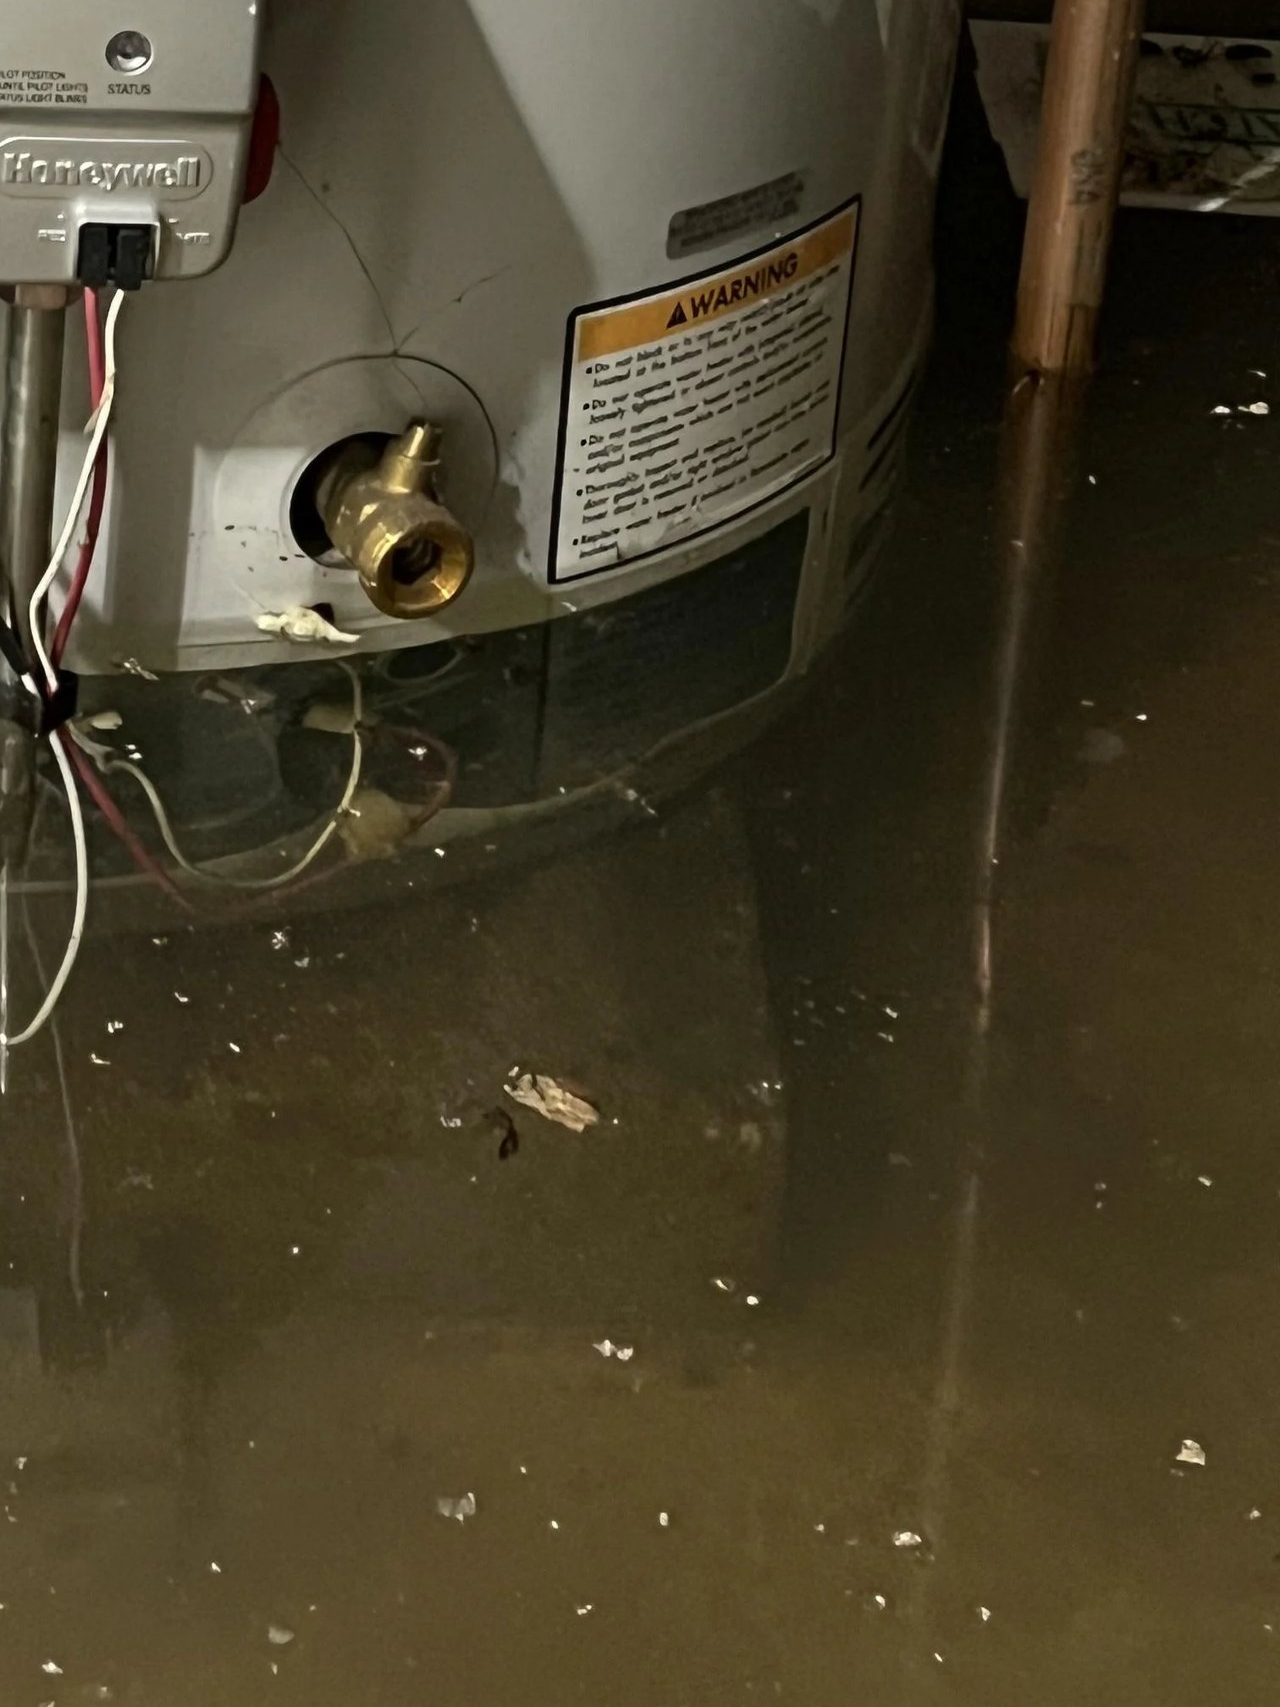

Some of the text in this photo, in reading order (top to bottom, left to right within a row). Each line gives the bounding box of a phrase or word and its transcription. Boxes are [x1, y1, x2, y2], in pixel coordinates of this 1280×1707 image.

[107, 84, 151, 95] STATUS
[1, 152, 201, 191] Honeywell
[690, 252, 798, 318] WARNING
